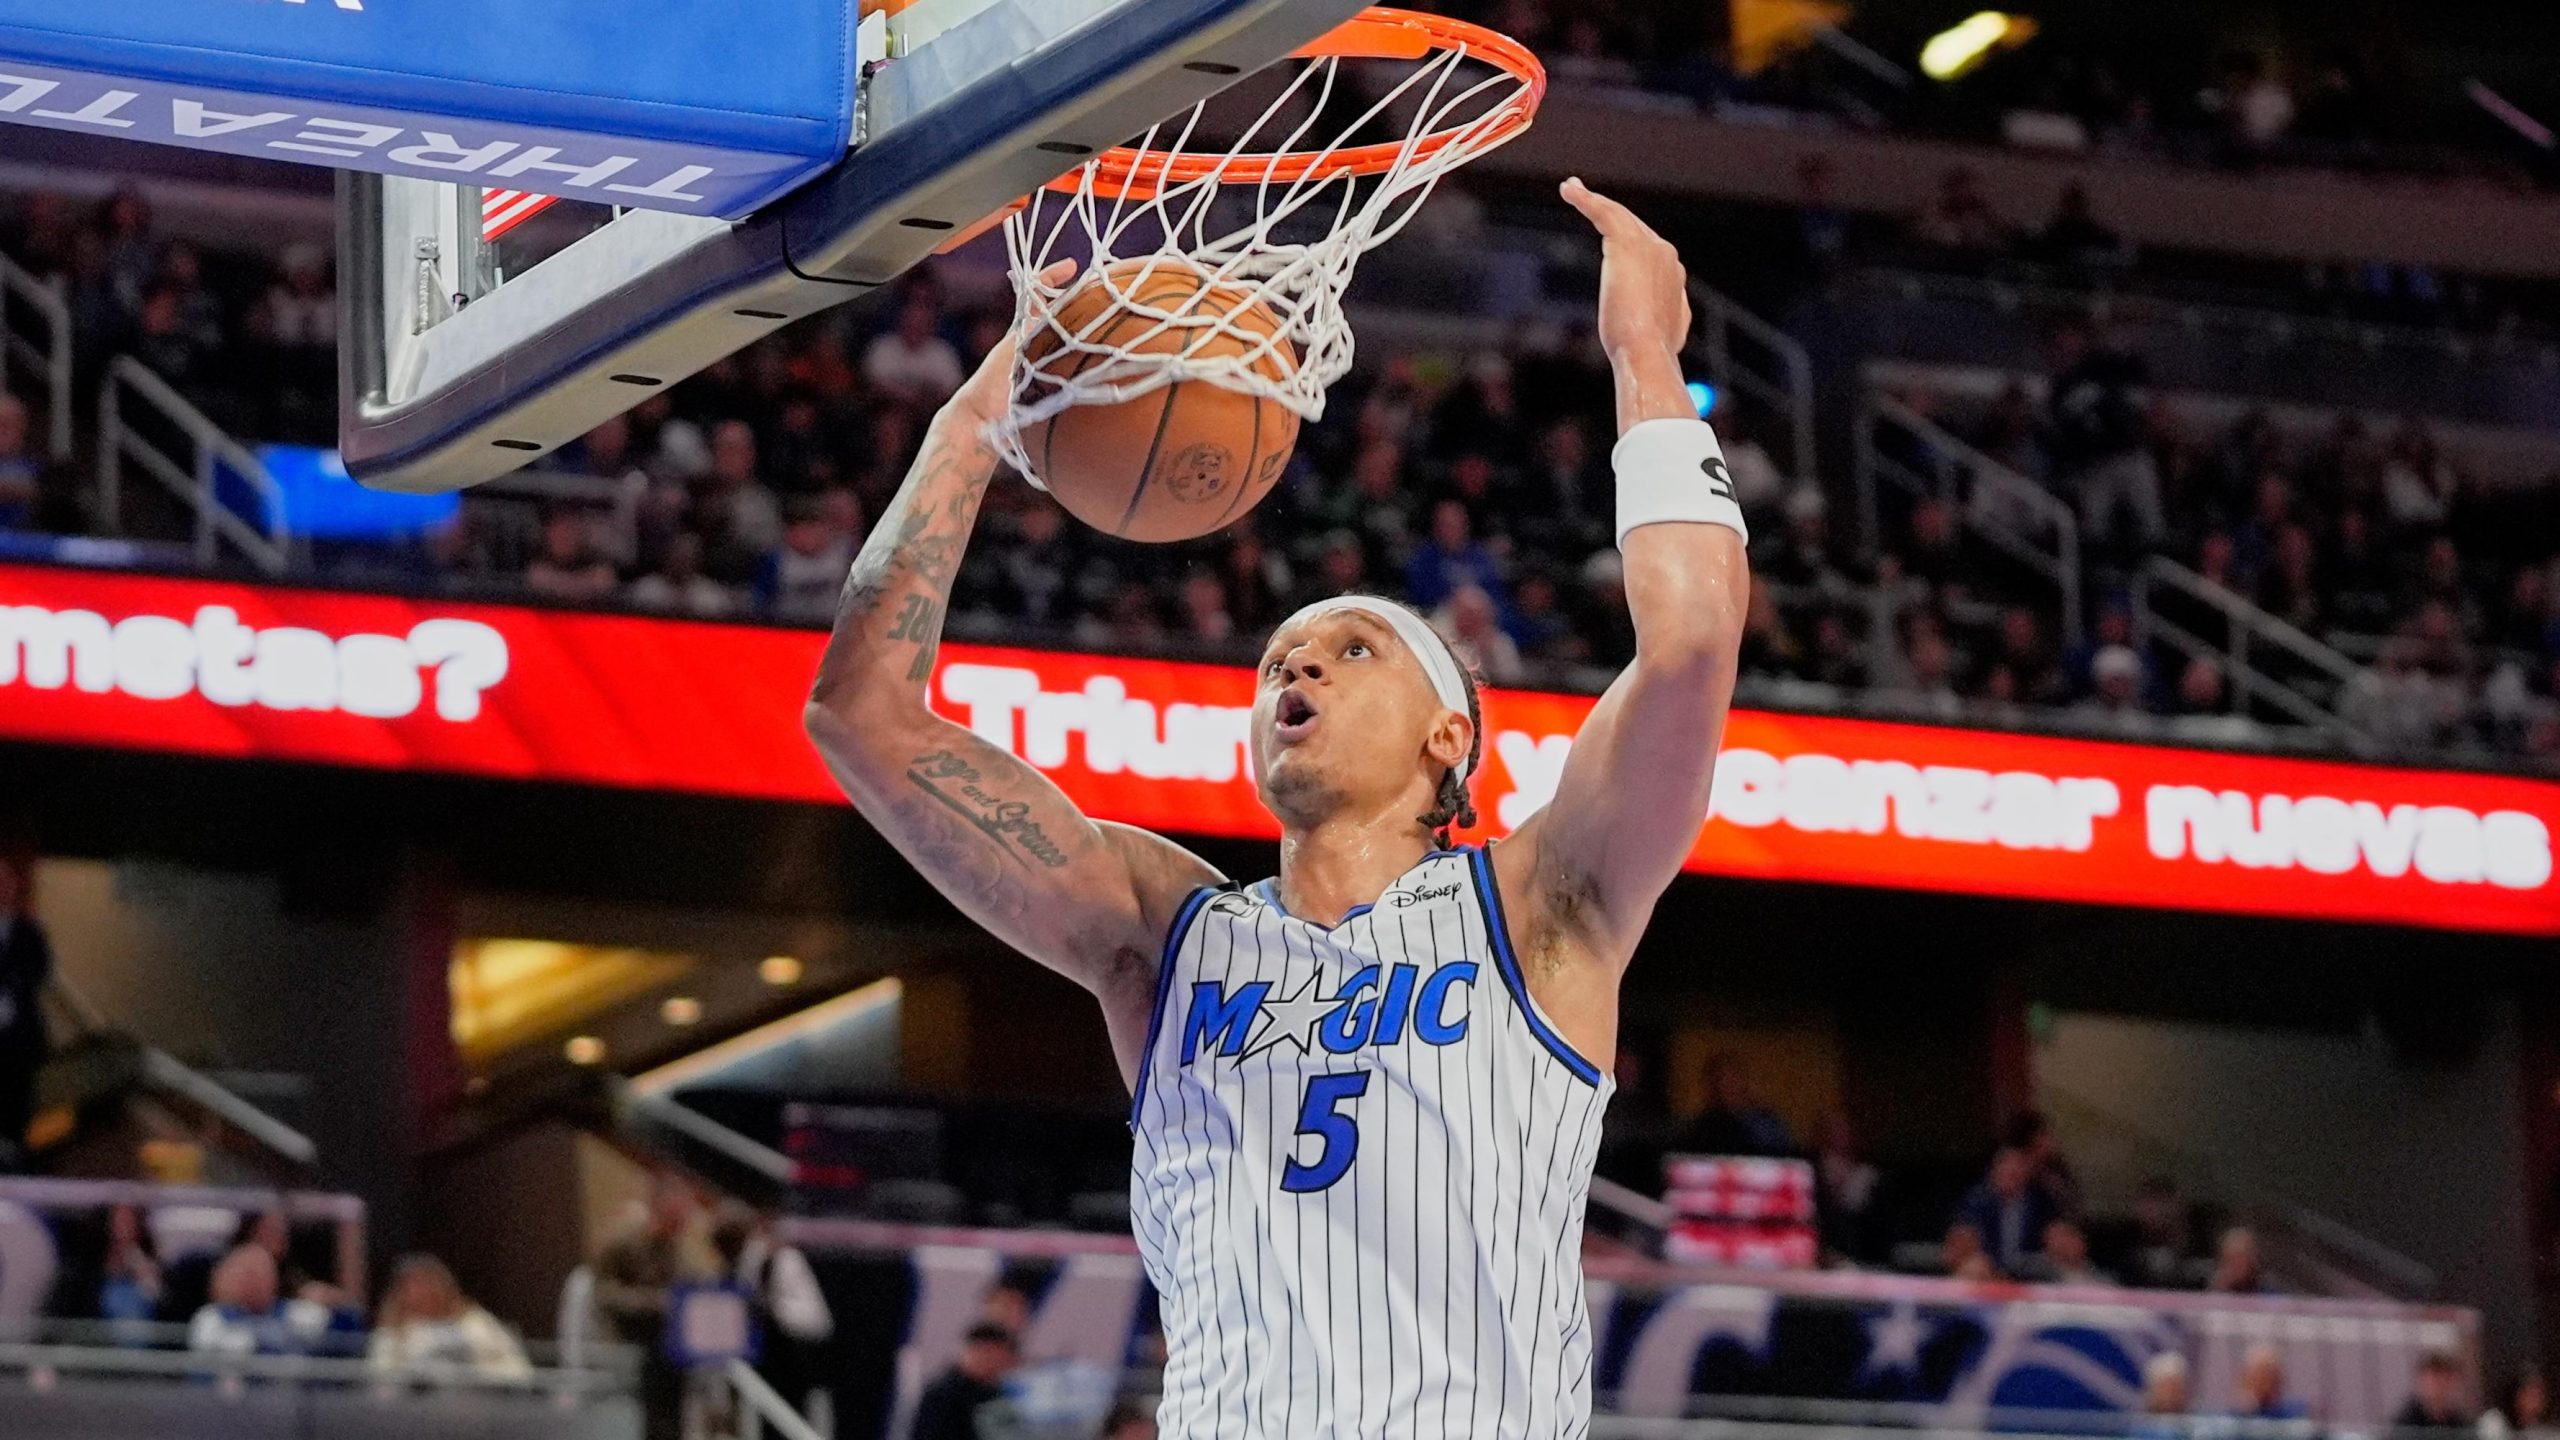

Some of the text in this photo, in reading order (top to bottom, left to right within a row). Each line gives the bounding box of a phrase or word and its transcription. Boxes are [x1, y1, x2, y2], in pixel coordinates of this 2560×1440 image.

[0, 605, 508, 722] metas?
[1706, 748, 2119, 852] canzar
[2146, 784, 2552, 889] nuevas
[1280, 1070, 1372, 1193] 5
